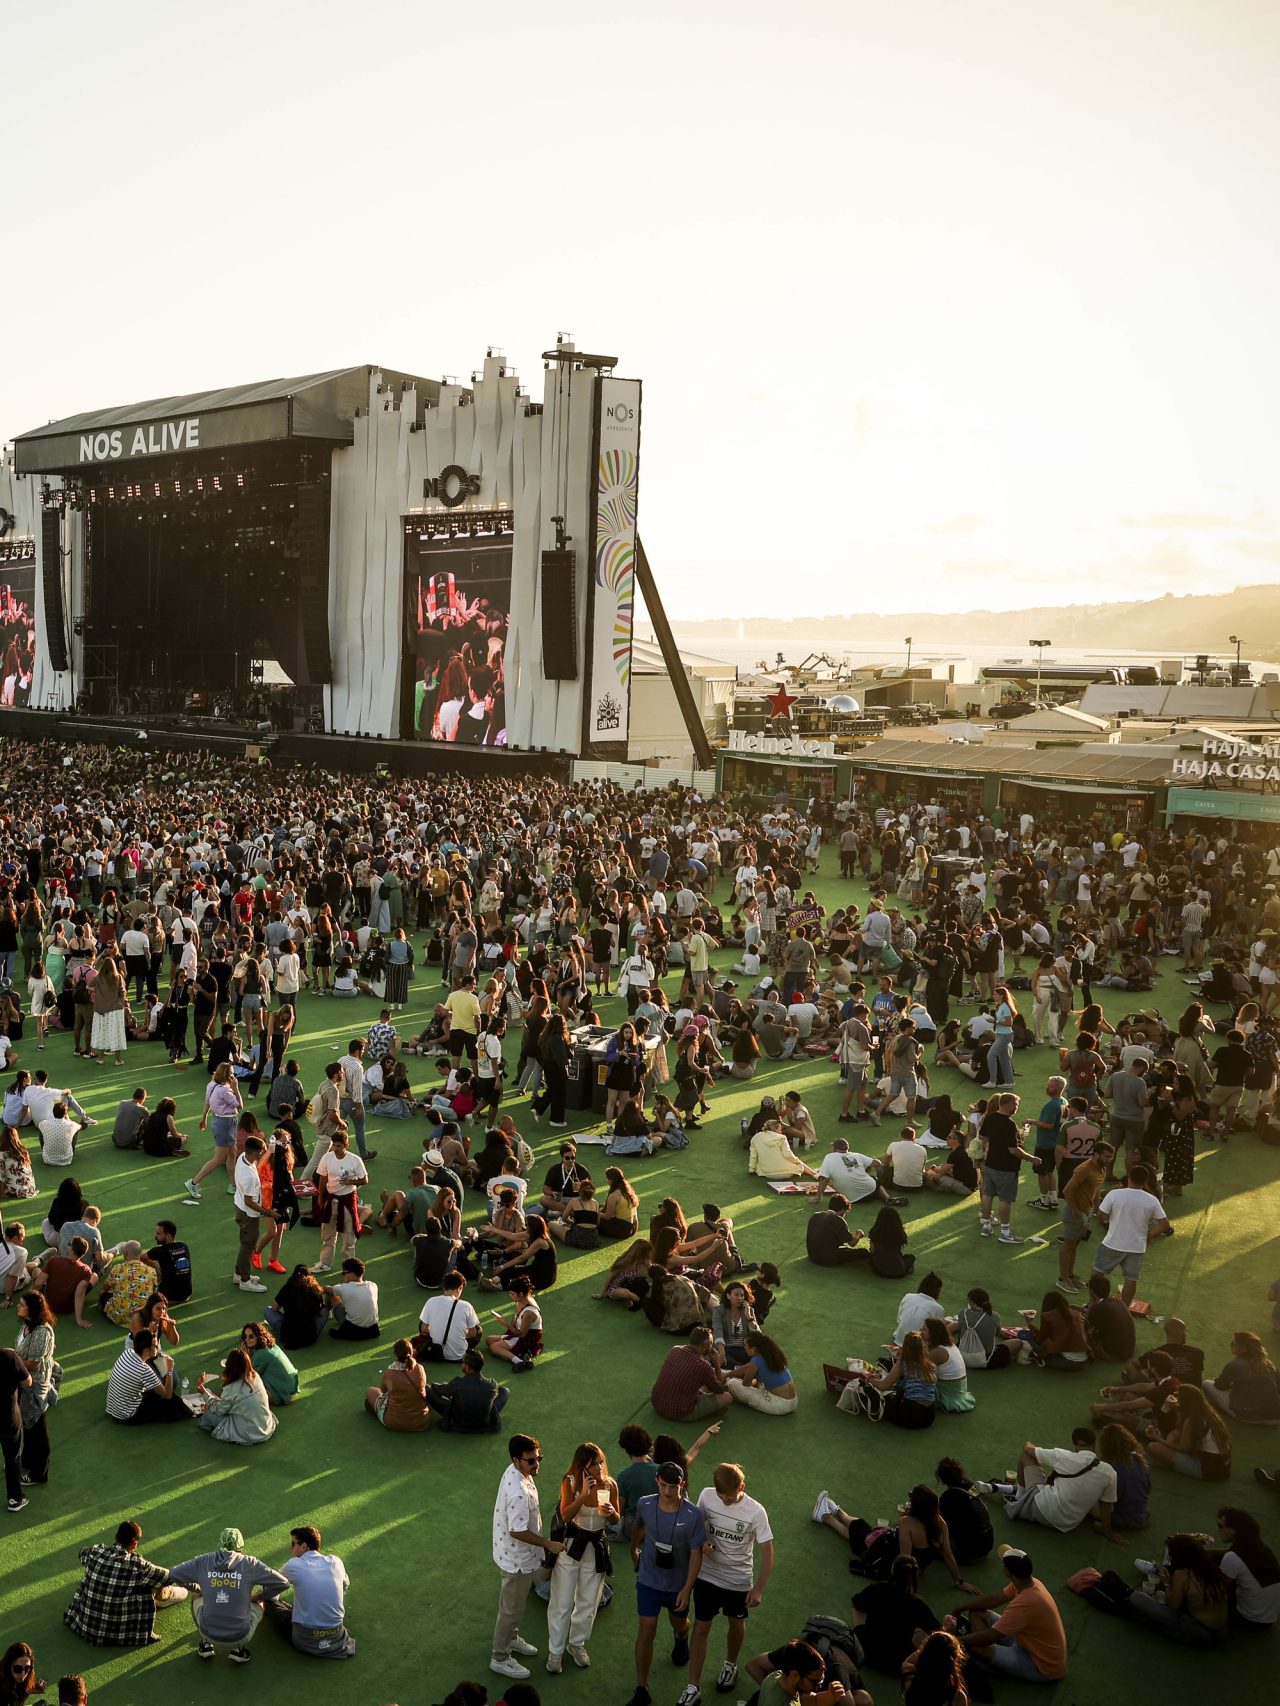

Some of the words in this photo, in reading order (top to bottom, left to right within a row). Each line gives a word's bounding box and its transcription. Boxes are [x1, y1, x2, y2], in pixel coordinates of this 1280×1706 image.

[607, 403, 633, 423] NOS
[80, 431, 123, 462] NOS
[130, 418, 200, 455] ALIVE
[423, 464, 481, 508] NOS
[598, 718, 618, 729] alive
[728, 729, 835, 759] Heineken
[1202, 739, 1254, 760] HAJA
[1172, 758, 1223, 779] HAJA
[1195, 801, 1215, 809] CAIXA
[788, 911, 817, 928] Ruffles
[1071, 1137, 1096, 1157] 22
[715, 1529, 744, 1542] BETANO
[207, 1571, 242, 1580] sounds
[210, 1578, 241, 1590] good!
